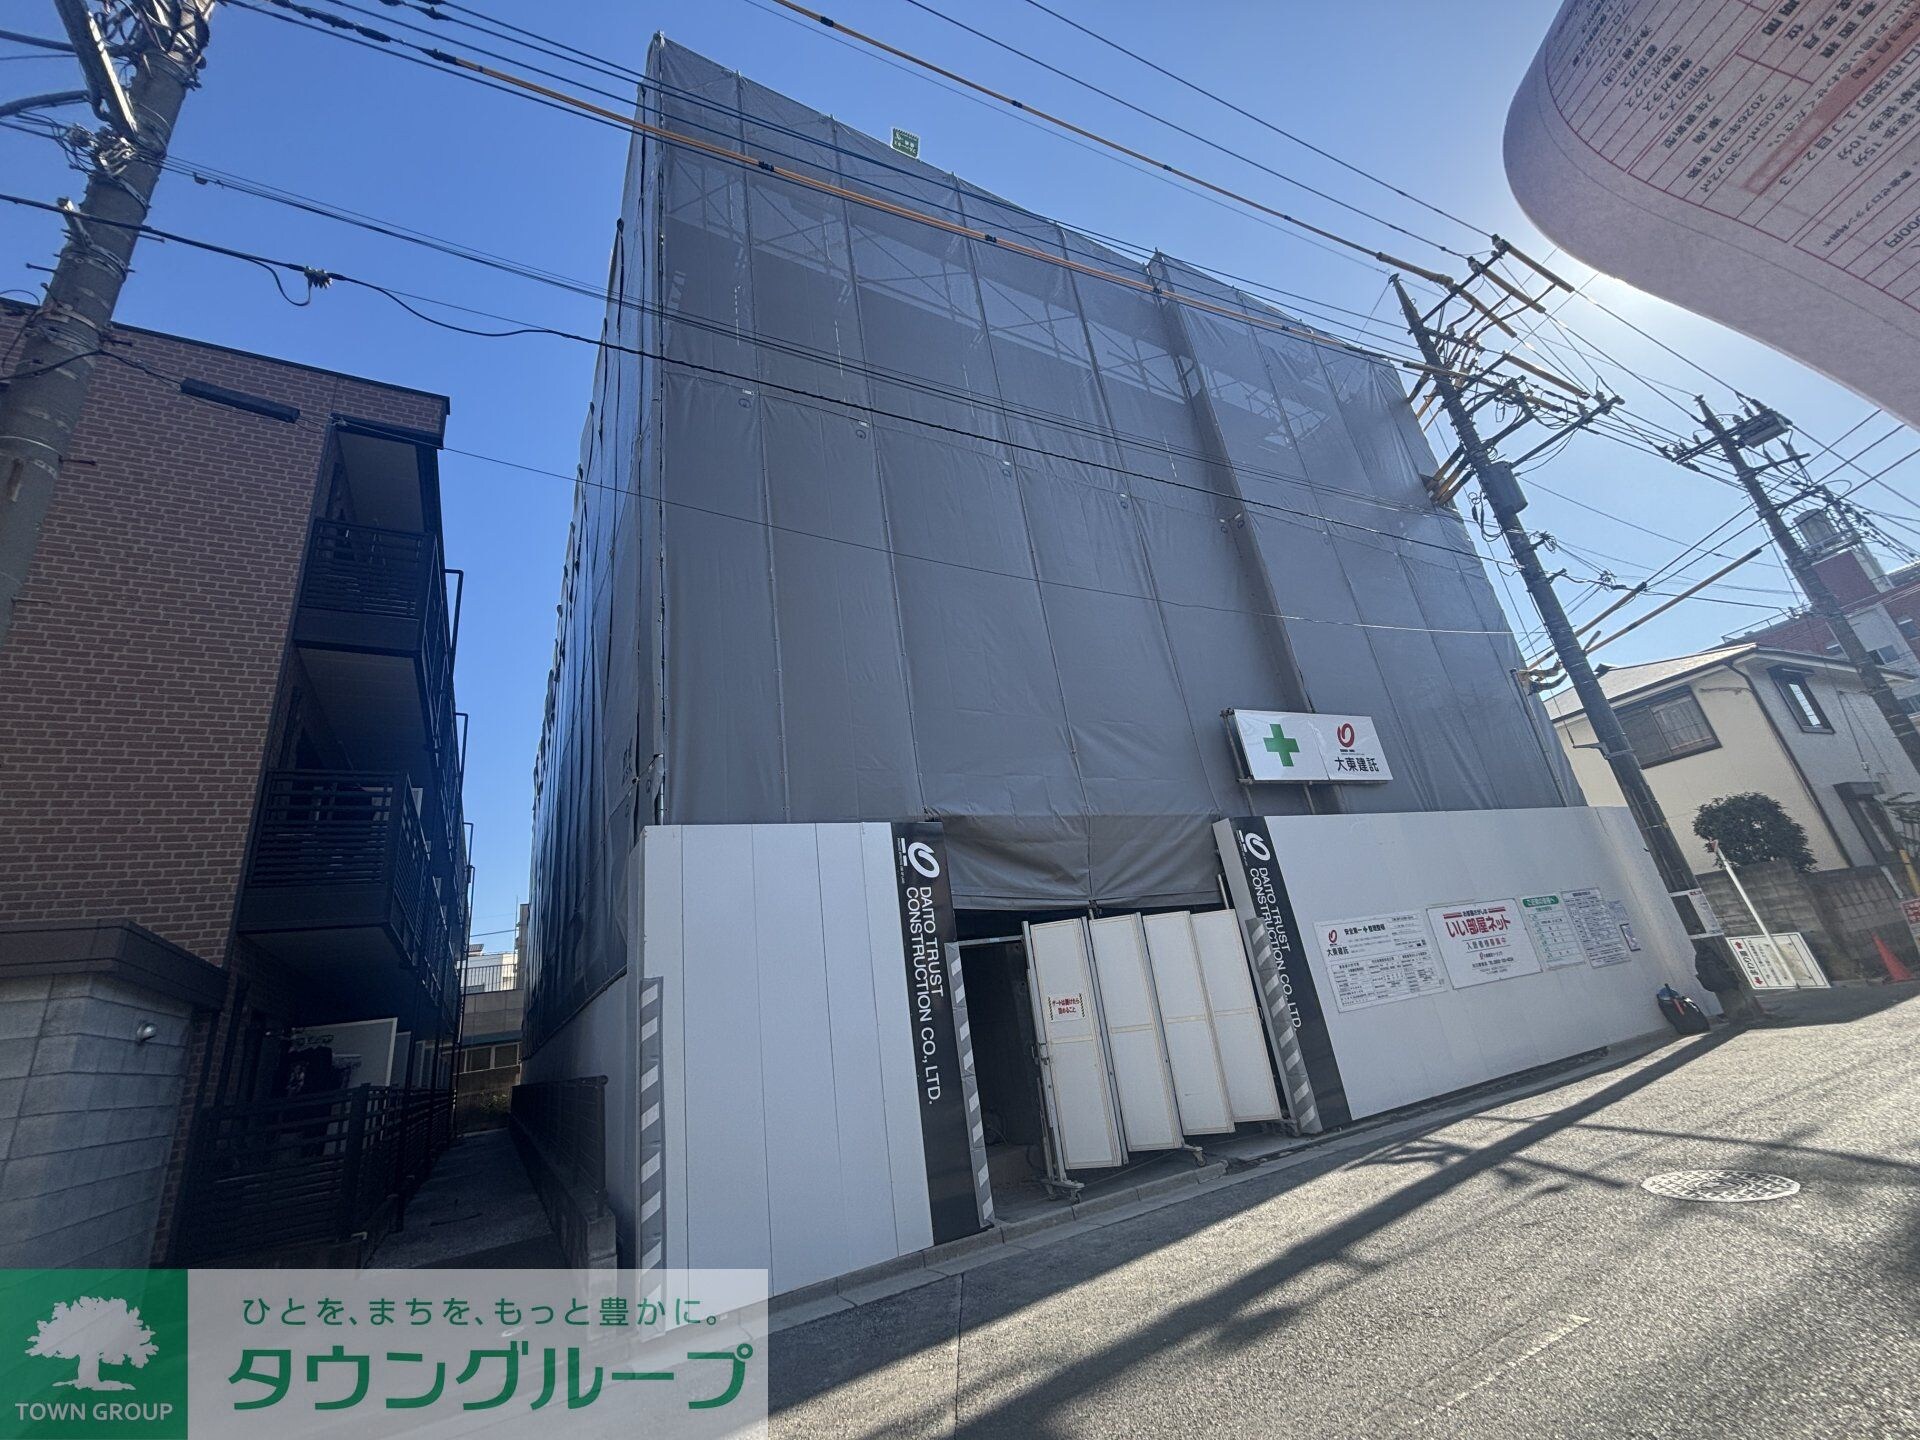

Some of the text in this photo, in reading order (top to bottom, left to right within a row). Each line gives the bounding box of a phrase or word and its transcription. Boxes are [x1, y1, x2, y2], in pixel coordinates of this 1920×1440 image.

[1600, 23, 1631, 67] シャワー
[1620, 44, 1657, 88] 都市ガス
[1624, 45, 1682, 108] 宅配ボックス
[1659, 66, 1709, 120] 防犯カメラ
[1334, 757, 1379, 772] 大東建託
[1258, 867, 1291, 952] DAITO TRUST
[1444, 912, 1513, 938] いい部屋ネット
[919, 886, 944, 997] DAITO TRUST
[1250, 868, 1287, 971] CONSTRUCTION
[1287, 1002, 1303, 1032] LTD.
[906, 886, 933, 1022] CONSTRUCTION
[923, 1068, 942, 1105] LTD.
